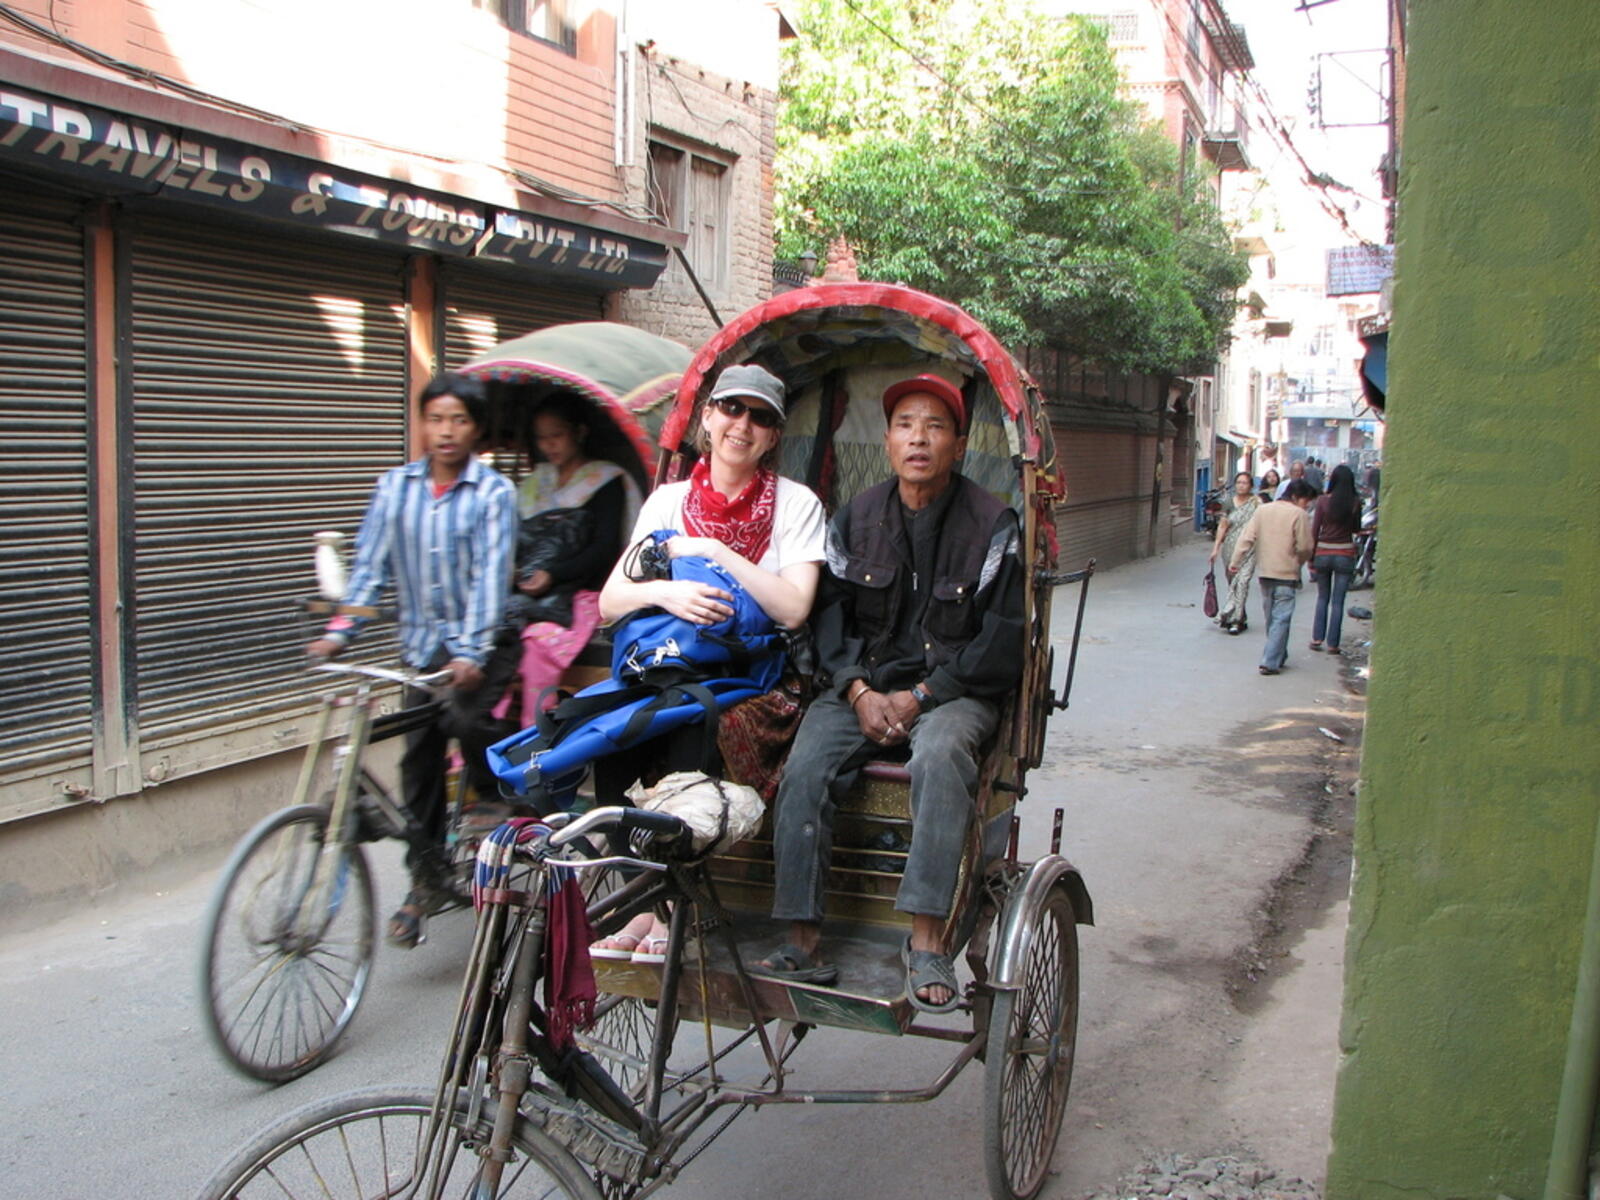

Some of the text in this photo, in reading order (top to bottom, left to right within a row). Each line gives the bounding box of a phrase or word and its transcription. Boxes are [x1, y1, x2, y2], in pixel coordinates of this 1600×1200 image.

[0, 92, 271, 201] TRAVELS
[291, 172, 333, 216] &
[358, 185, 479, 245] TOURS
[503, 219, 576, 264] PVT.
